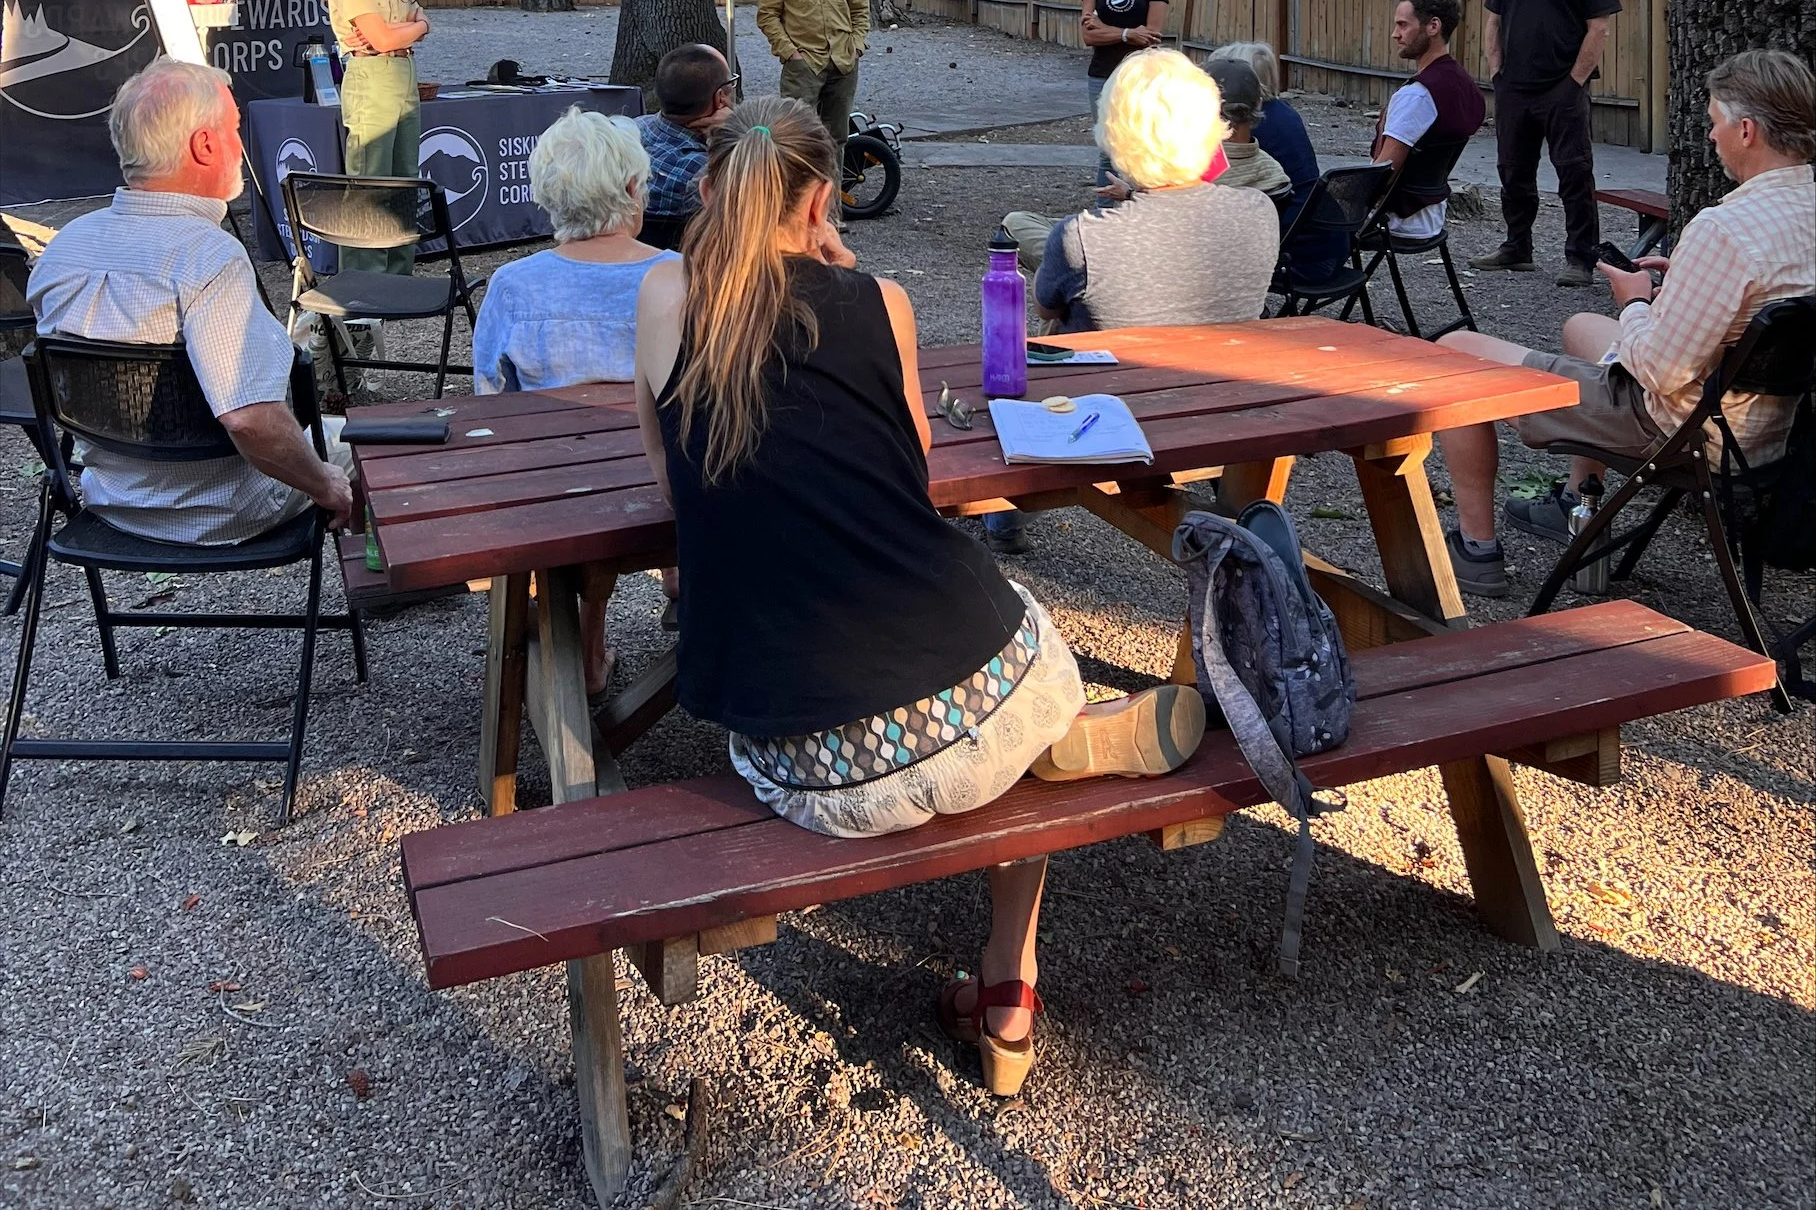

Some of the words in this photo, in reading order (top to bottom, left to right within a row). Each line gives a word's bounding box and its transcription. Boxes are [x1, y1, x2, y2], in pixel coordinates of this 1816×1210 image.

[209, 39, 284, 73] ORPS
[499, 135, 539, 157] SISKI
[500, 184, 533, 205] COR
